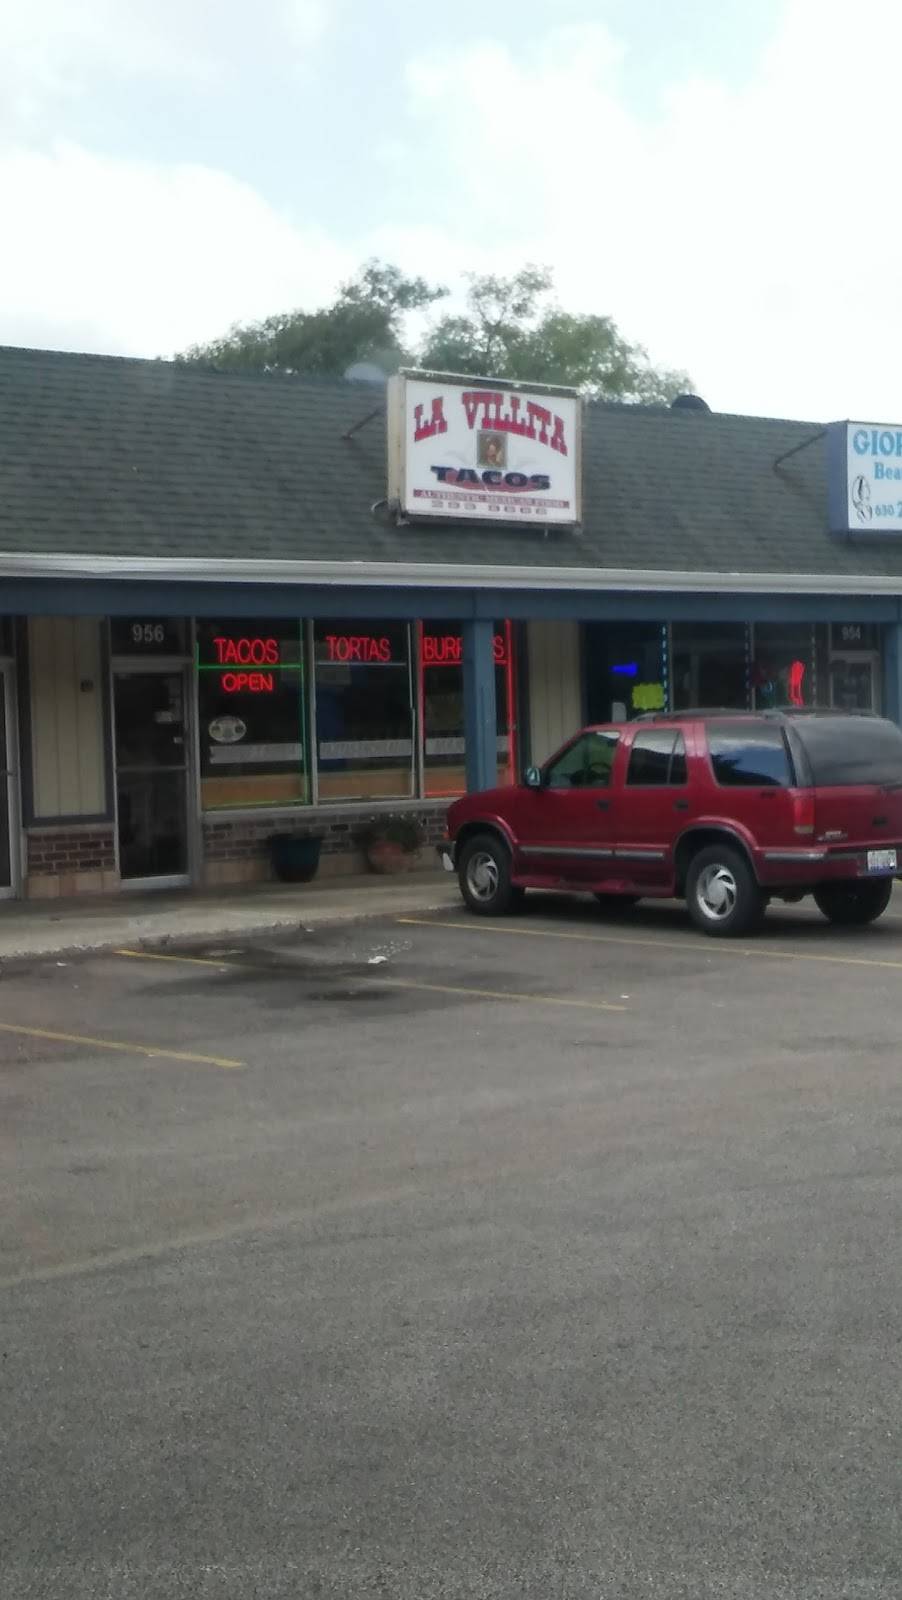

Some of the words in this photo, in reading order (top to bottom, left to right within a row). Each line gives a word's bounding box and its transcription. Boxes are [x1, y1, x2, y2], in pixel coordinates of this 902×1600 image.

[414, 397, 448, 442] LA
[461, 391, 568, 456] VILLITA
[430, 465, 551, 490] TACOS
[132, 624, 164, 642] 956
[214, 638, 278, 664] TACOS
[326, 636, 391, 661] TORTAS
[222, 672, 273, 692] OPEN
